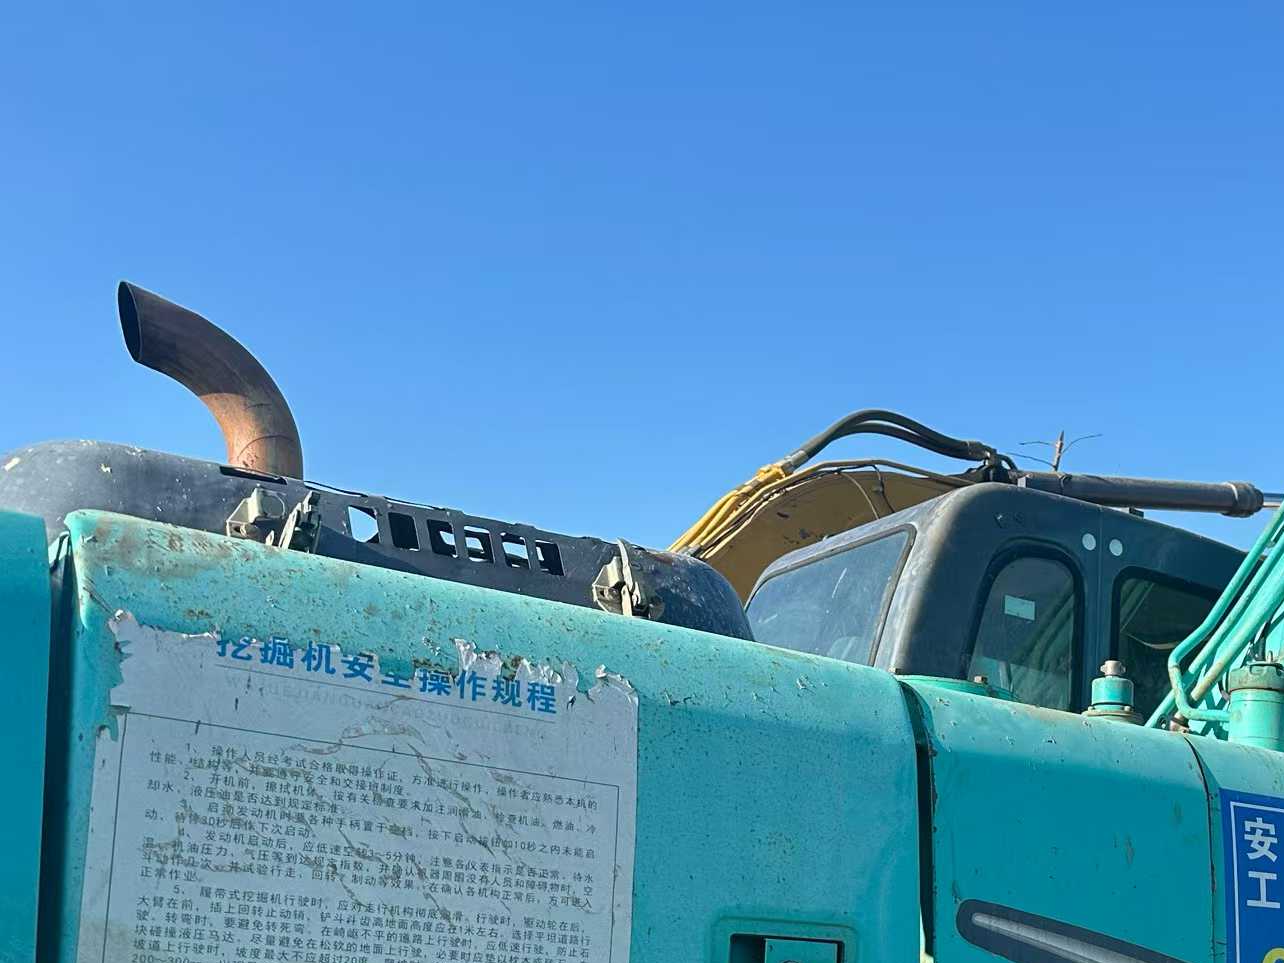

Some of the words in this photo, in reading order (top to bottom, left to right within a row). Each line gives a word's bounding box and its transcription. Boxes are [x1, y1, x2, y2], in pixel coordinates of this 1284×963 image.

[216, 637, 557, 714] 挖掘机安操作规程
